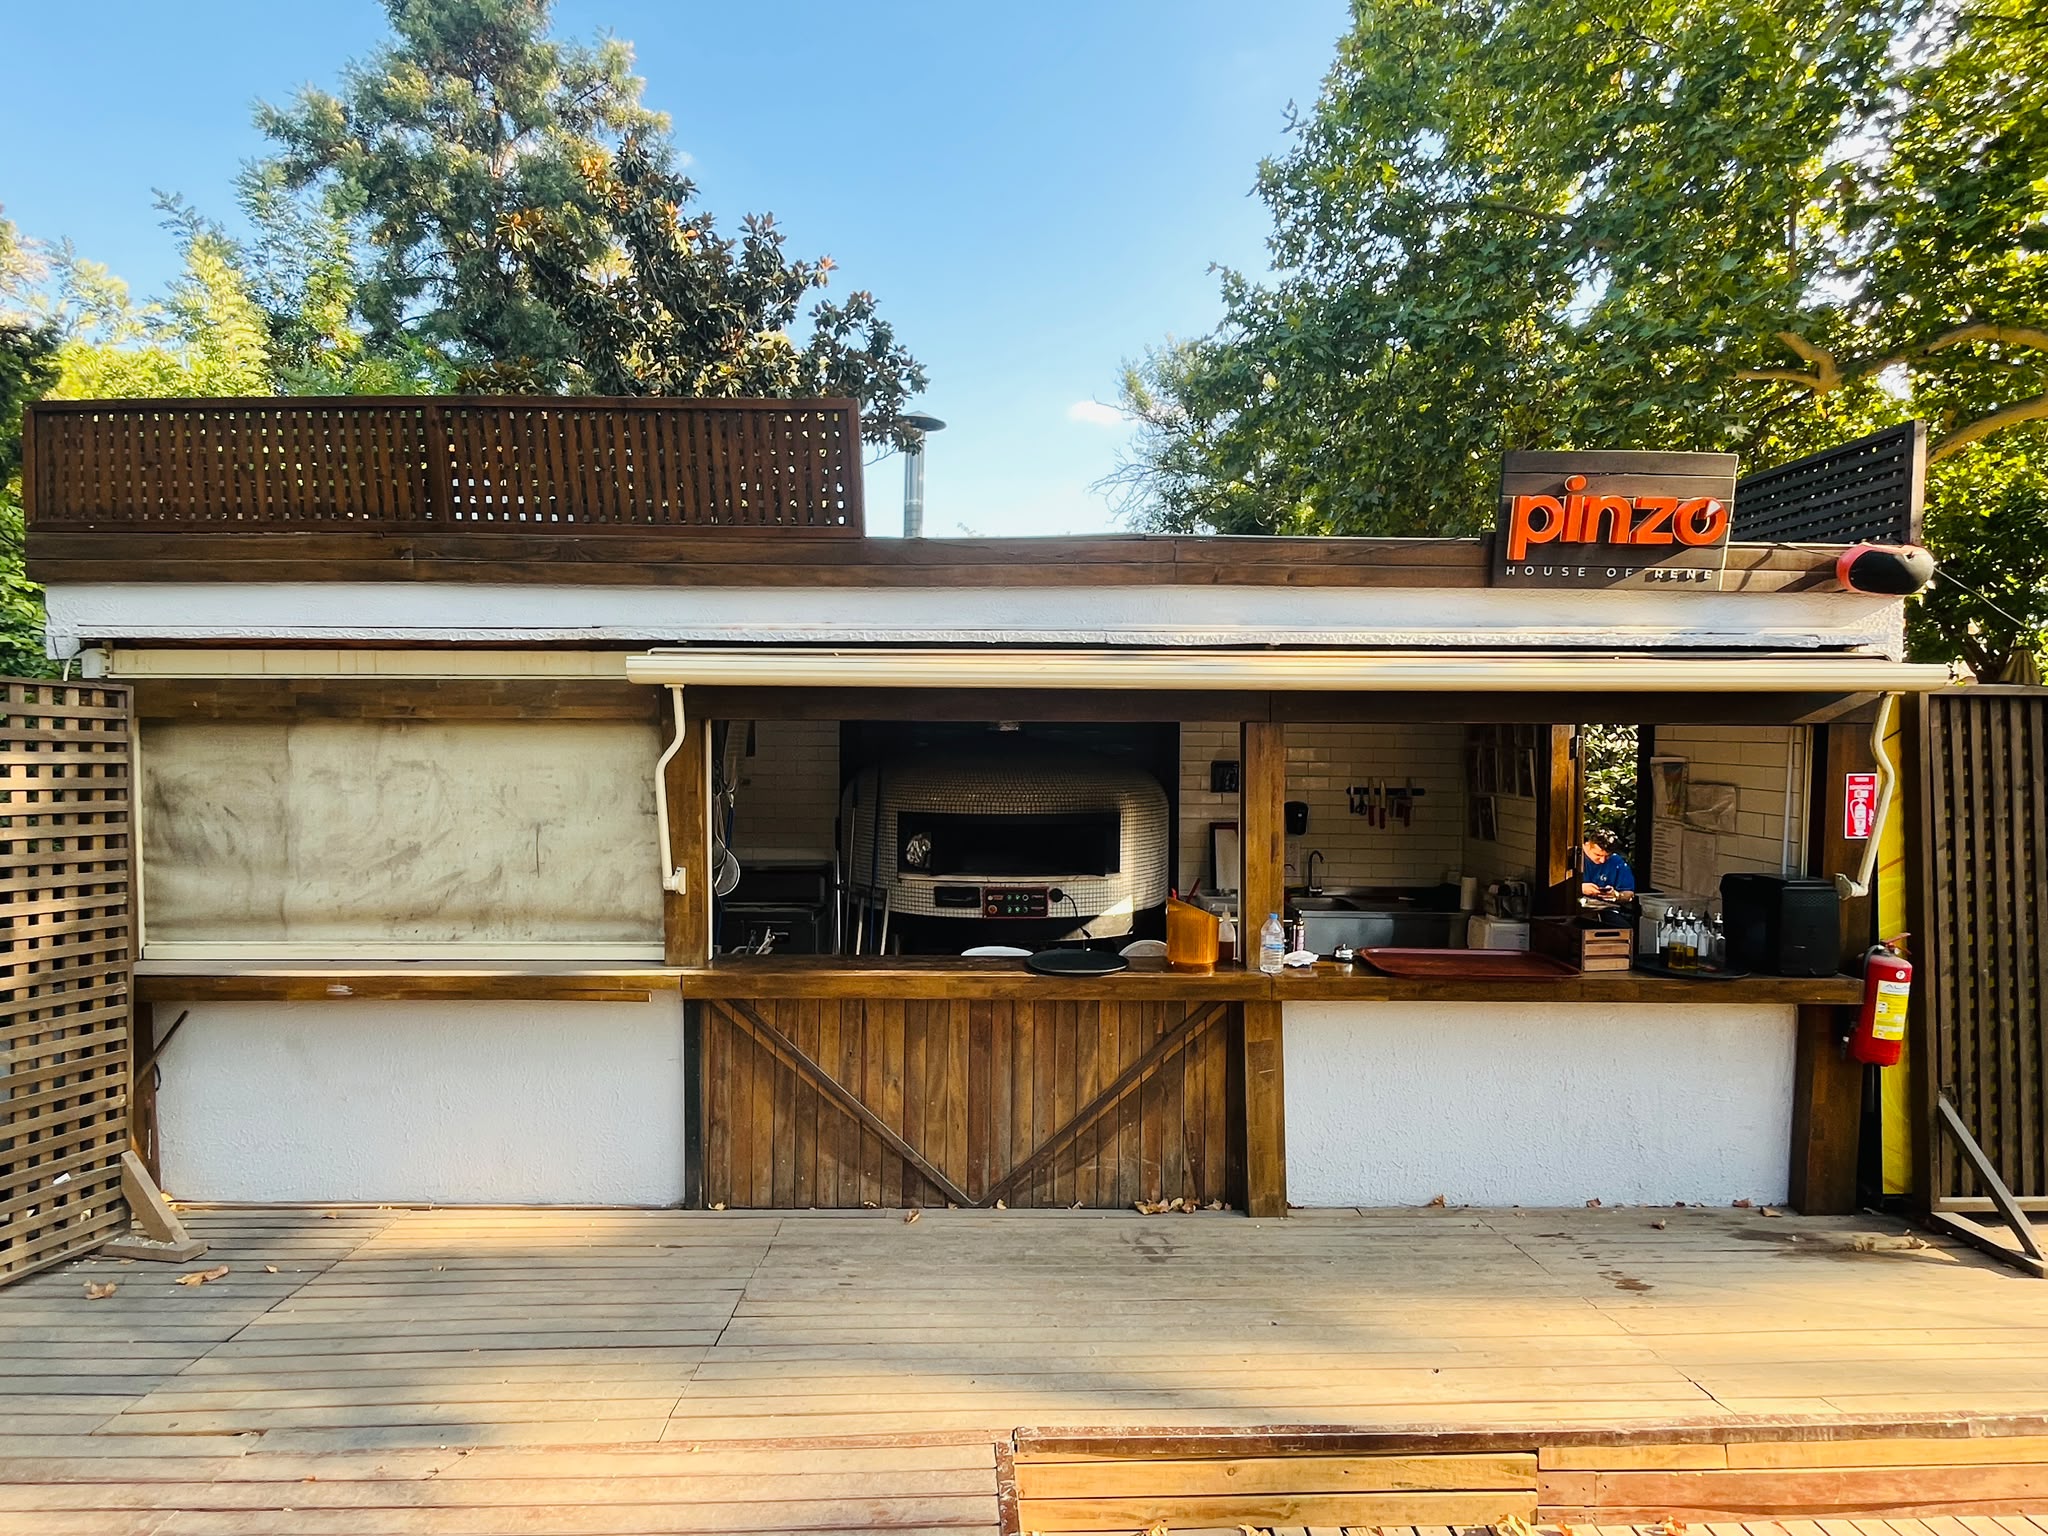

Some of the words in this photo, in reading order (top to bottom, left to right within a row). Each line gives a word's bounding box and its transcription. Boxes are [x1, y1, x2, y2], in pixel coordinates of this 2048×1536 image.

[1507, 474, 1728, 561] pinzo
[1506, 566, 1586, 577] HOUSE
[1606, 567, 1633, 578] OF
[1654, 568, 1713, 579] RENE
